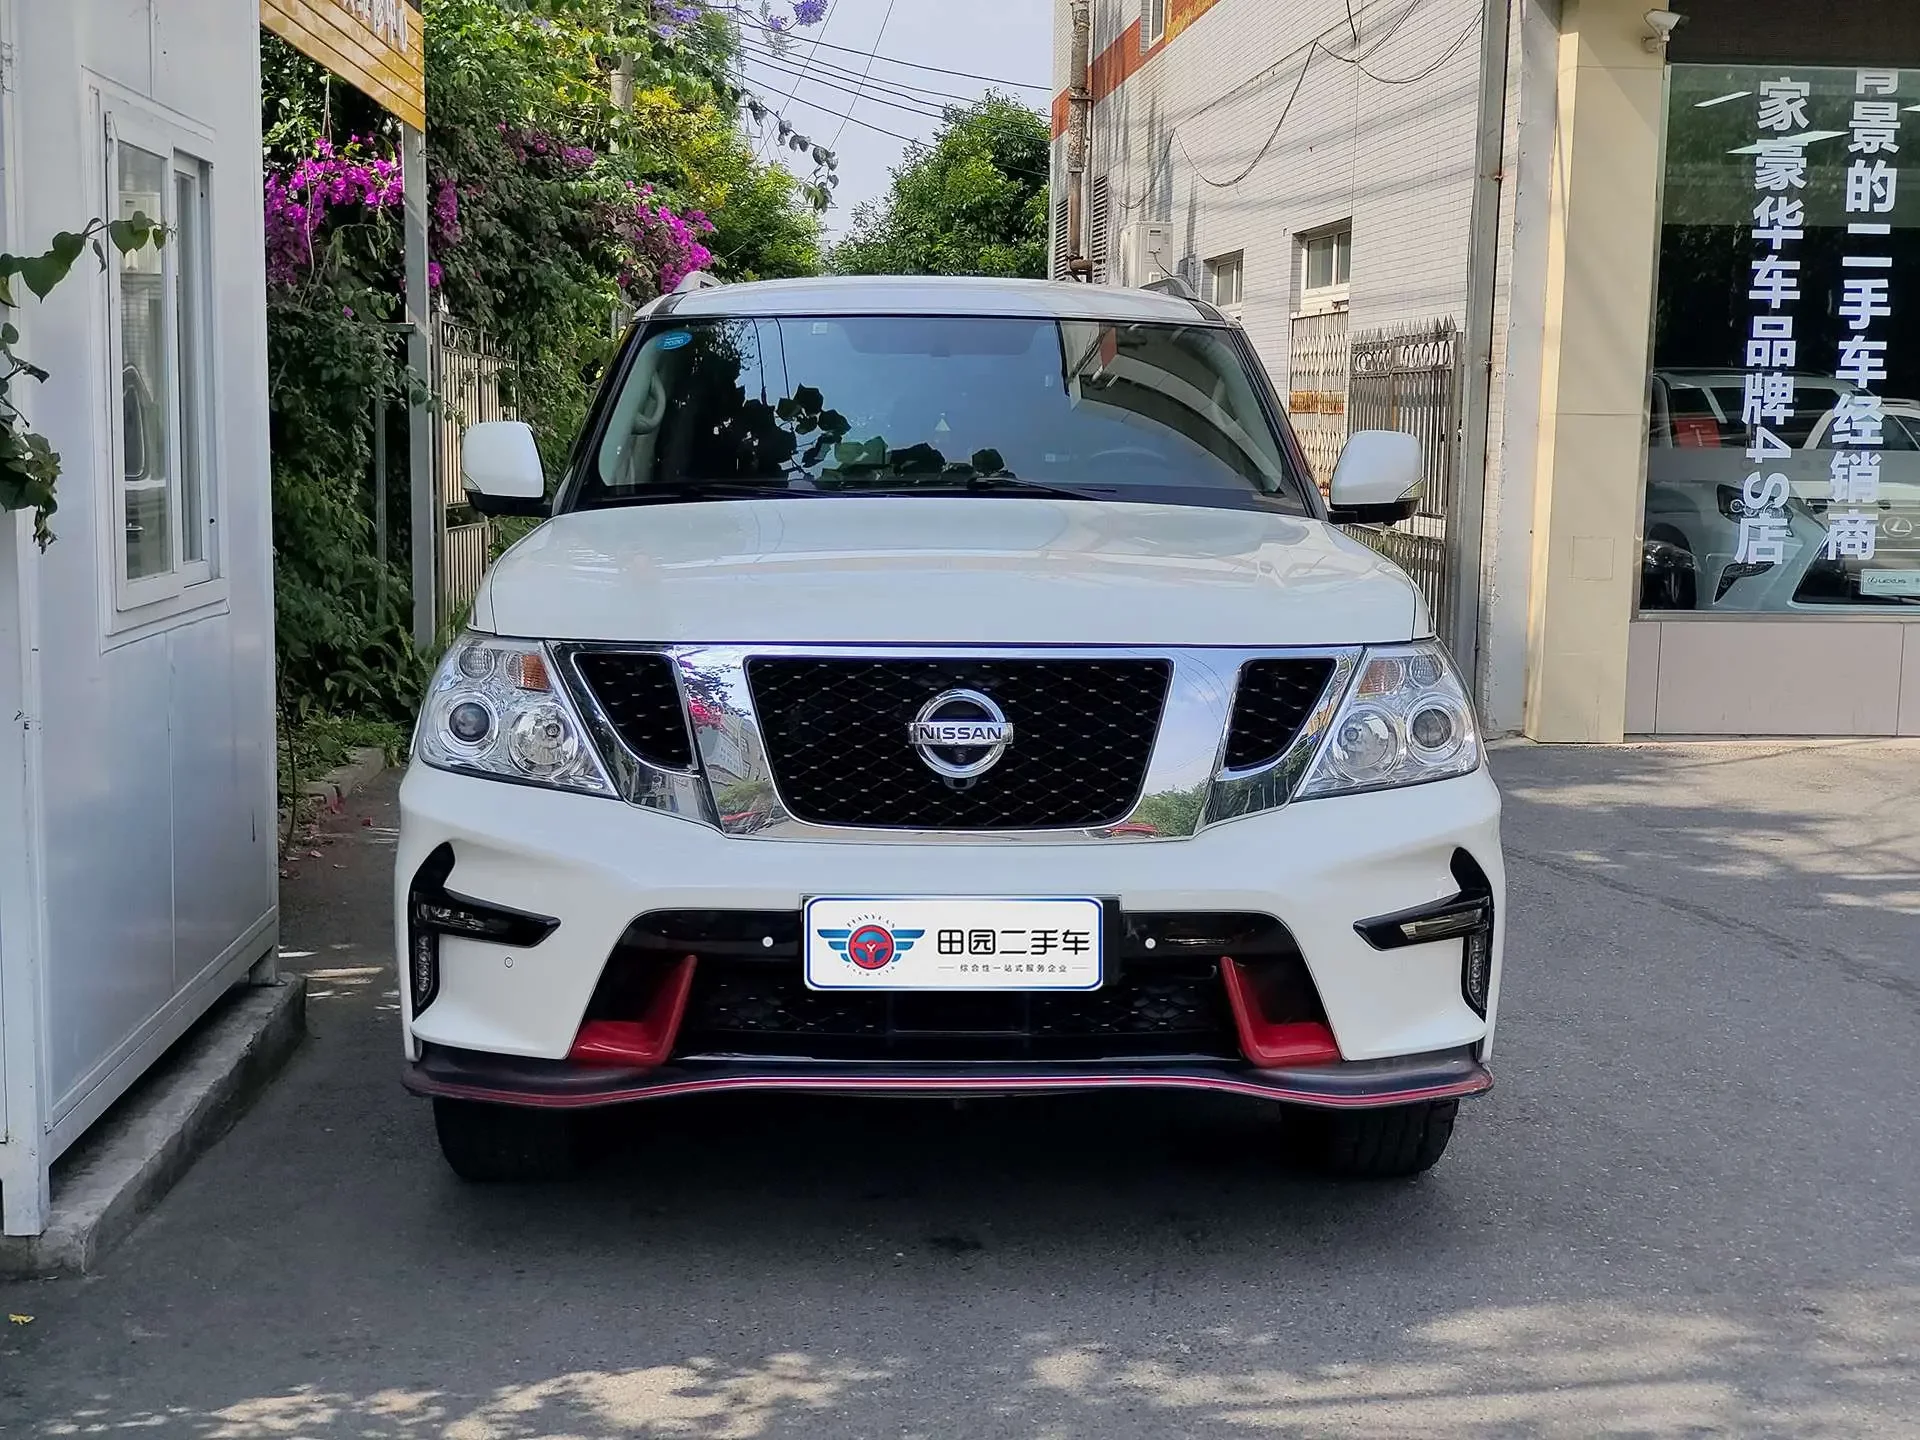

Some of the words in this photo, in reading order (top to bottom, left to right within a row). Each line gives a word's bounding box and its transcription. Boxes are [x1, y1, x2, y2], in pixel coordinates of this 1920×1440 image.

[1734, 76, 1810, 565] 家豪华车品牌4S店
[919, 727, 1002, 740] NISSAN
[937, 929, 1090, 955] 田园二手车
[959, 964, 1068, 973] 综合性一站式服务企业
